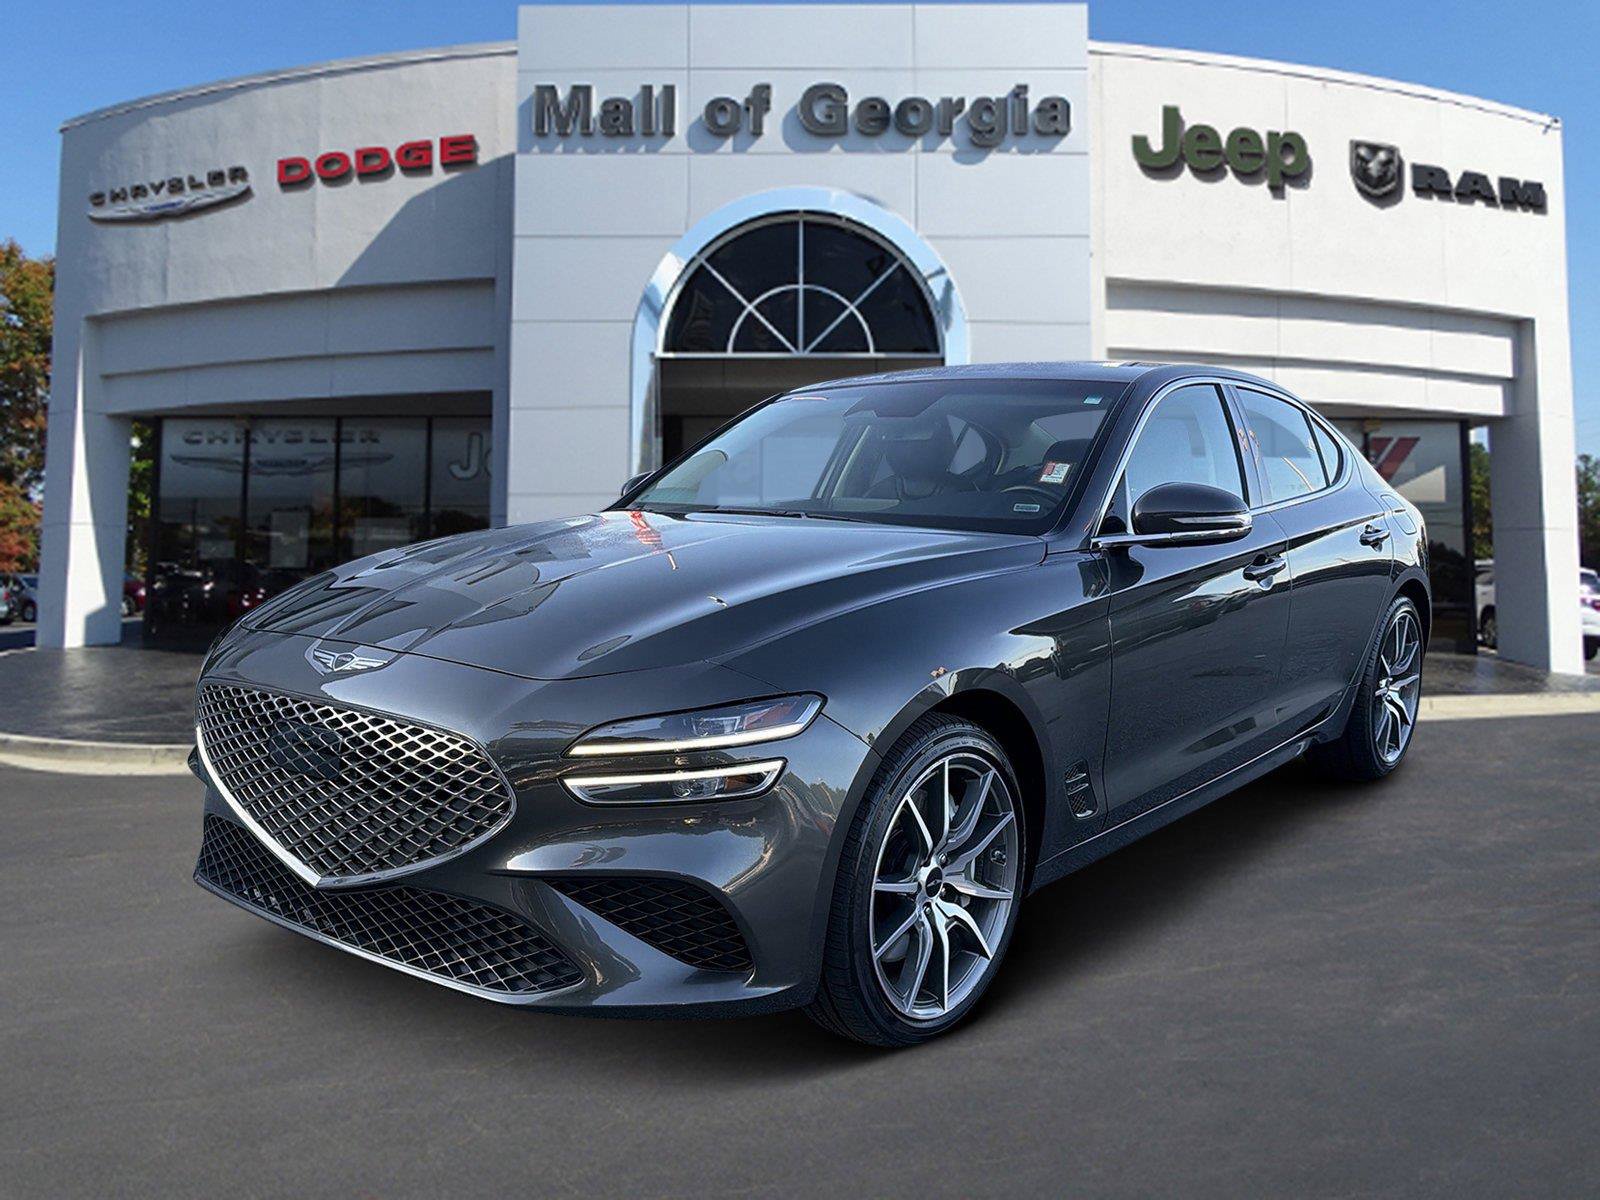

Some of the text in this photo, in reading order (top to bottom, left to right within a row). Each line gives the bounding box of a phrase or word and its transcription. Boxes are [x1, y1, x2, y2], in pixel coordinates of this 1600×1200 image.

[534, 82, 1073, 149] Mall of Georgia
[277, 134, 477, 187] DODGE
[1131, 105, 1310, 196] Jeep
[89, 165, 249, 206] CHRYSLER
[1410, 162, 1548, 214] RAM
